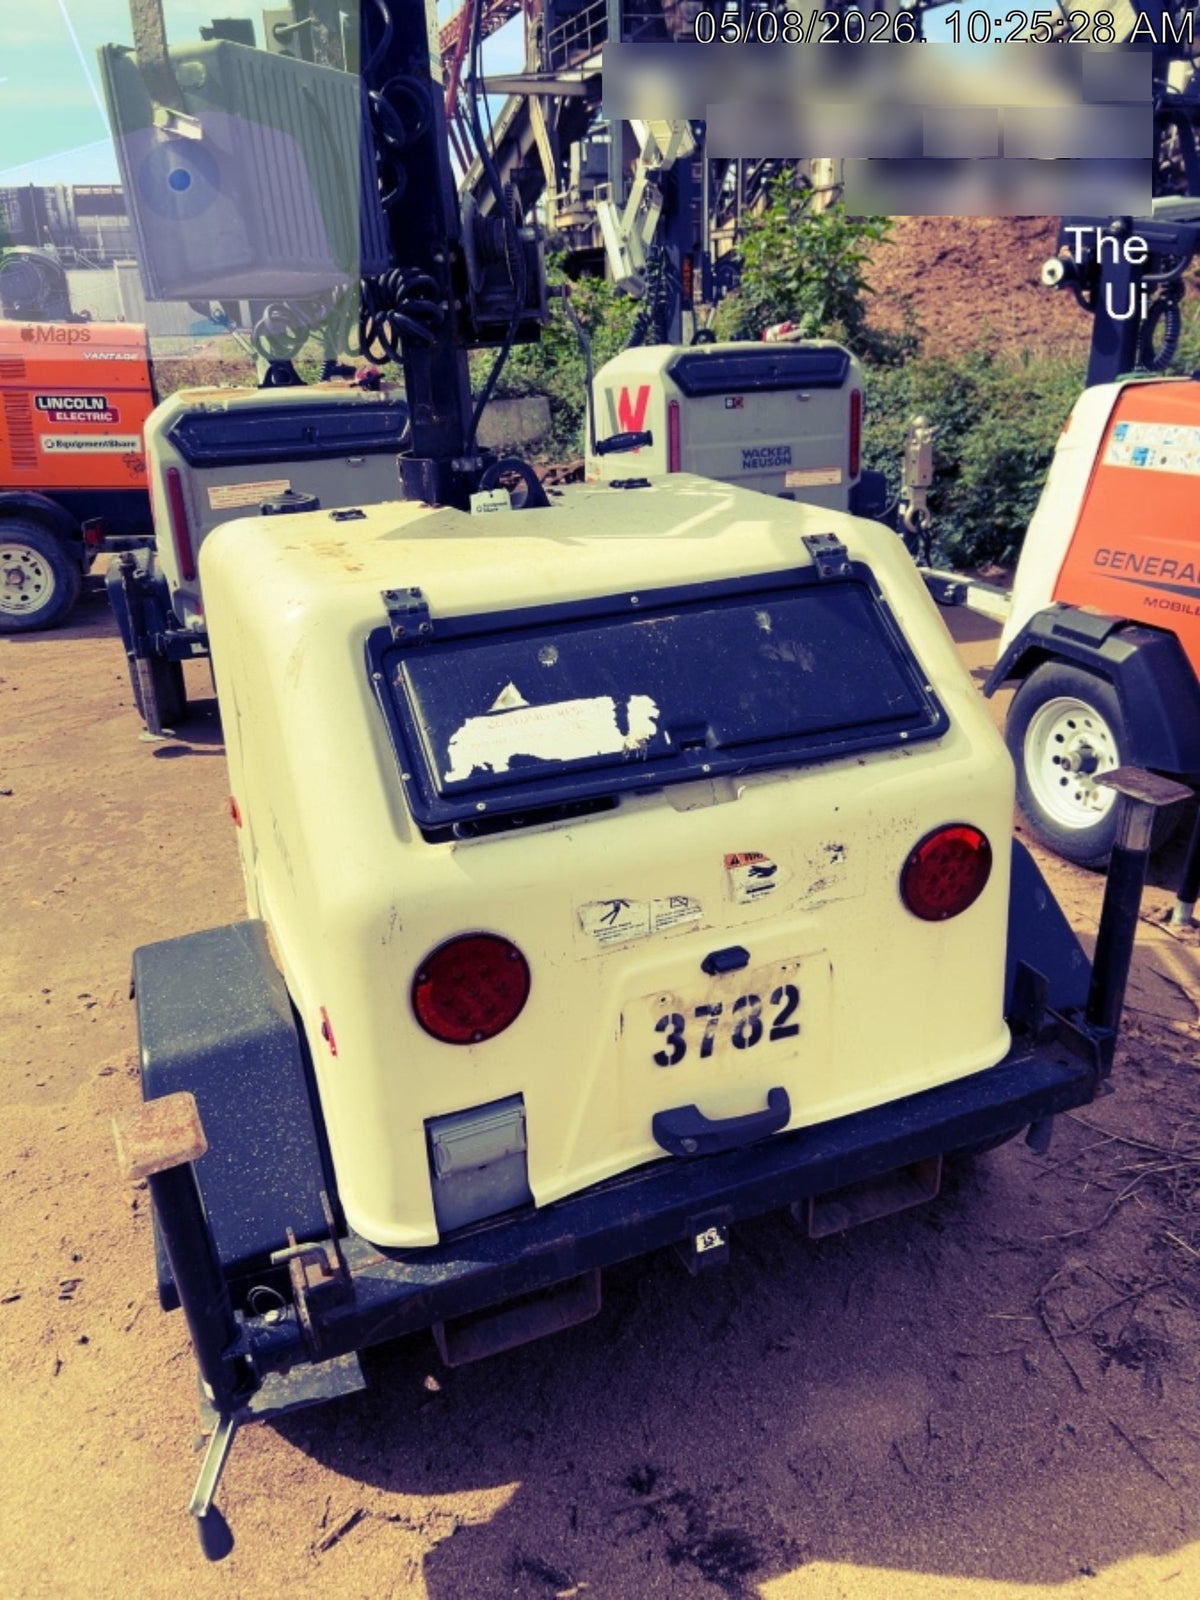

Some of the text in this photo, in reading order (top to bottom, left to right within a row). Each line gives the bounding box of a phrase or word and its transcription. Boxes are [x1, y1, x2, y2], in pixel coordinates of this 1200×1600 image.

[38, 397, 104, 410] LINCOLN
[56, 412, 113, 422] ELECTRIC
[742, 446, 791, 458] WACKER
[742, 456, 792, 469] NEUSON
[1094, 548, 1200, 584] GENERA
[653, 984, 800, 1067] 3782
